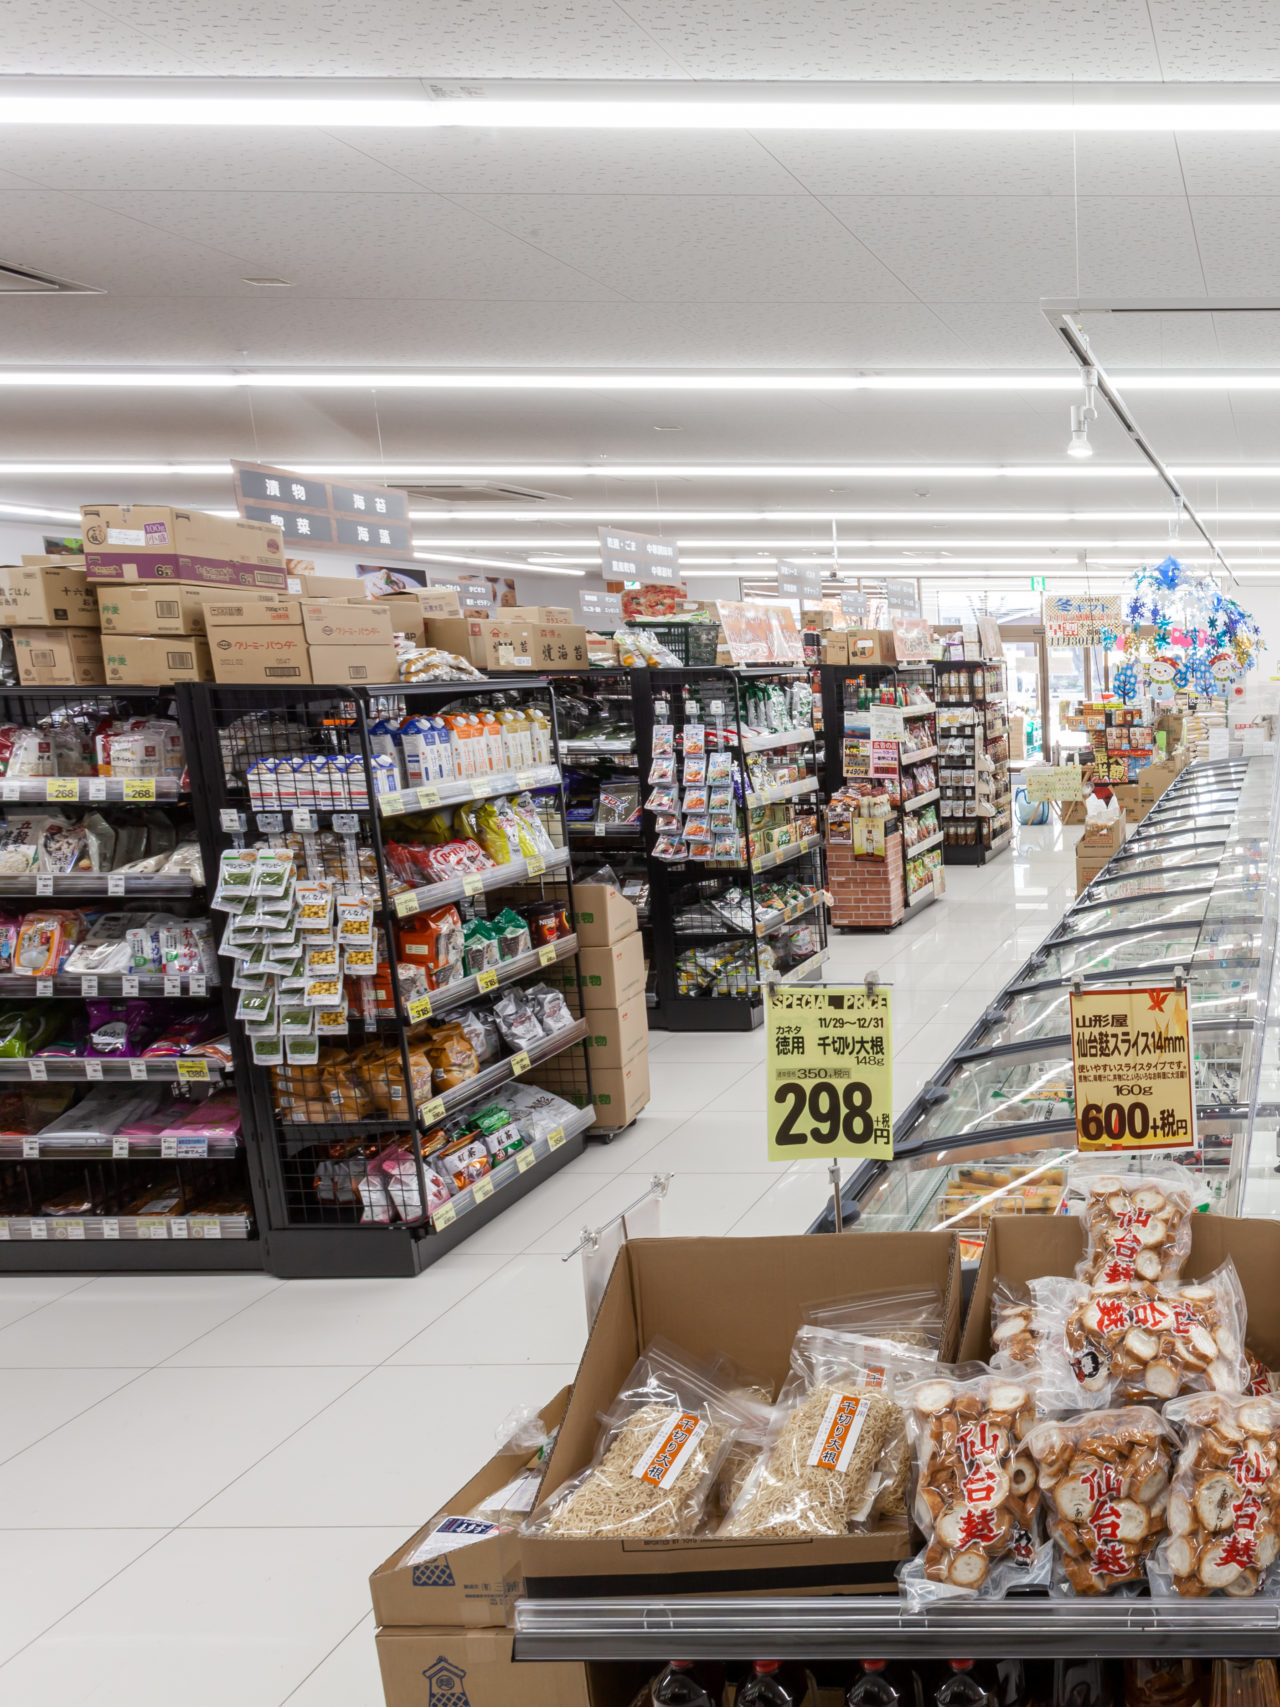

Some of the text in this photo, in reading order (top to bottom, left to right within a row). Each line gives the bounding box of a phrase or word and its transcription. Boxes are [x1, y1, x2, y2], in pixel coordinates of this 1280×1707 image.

[265, 479, 306, 501] 漬物
[353, 494, 387, 513] 海苔
[1054, 598, 1109, 612] 冬ギフト
[233, 642, 298, 651] クリーミーパウダー
[1093, 764, 1124, 780] 半額
[55, 789, 74, 799] 268
[132, 789, 151, 799] 268
[772, 994, 888, 1010] SPECIAL PRICE
[1076, 1014, 1129, 1029] 山形屋
[776, 1026, 801, 1035] カネタ
[776, 1036, 885, 1056] 徳用 千切り大根
[854, 1056, 885, 1066] 148g
[1078, 1061, 1187, 1074] 使いやすいスライスタイプです。
[1113, 1084, 1153, 1096] 160g
[774, 1081, 874, 1146] 298
[874, 1129, 890, 1145] 円
[821, 1400, 857, 1465] 千切り大根
[646, 1418, 695, 1482] 千切り大根
